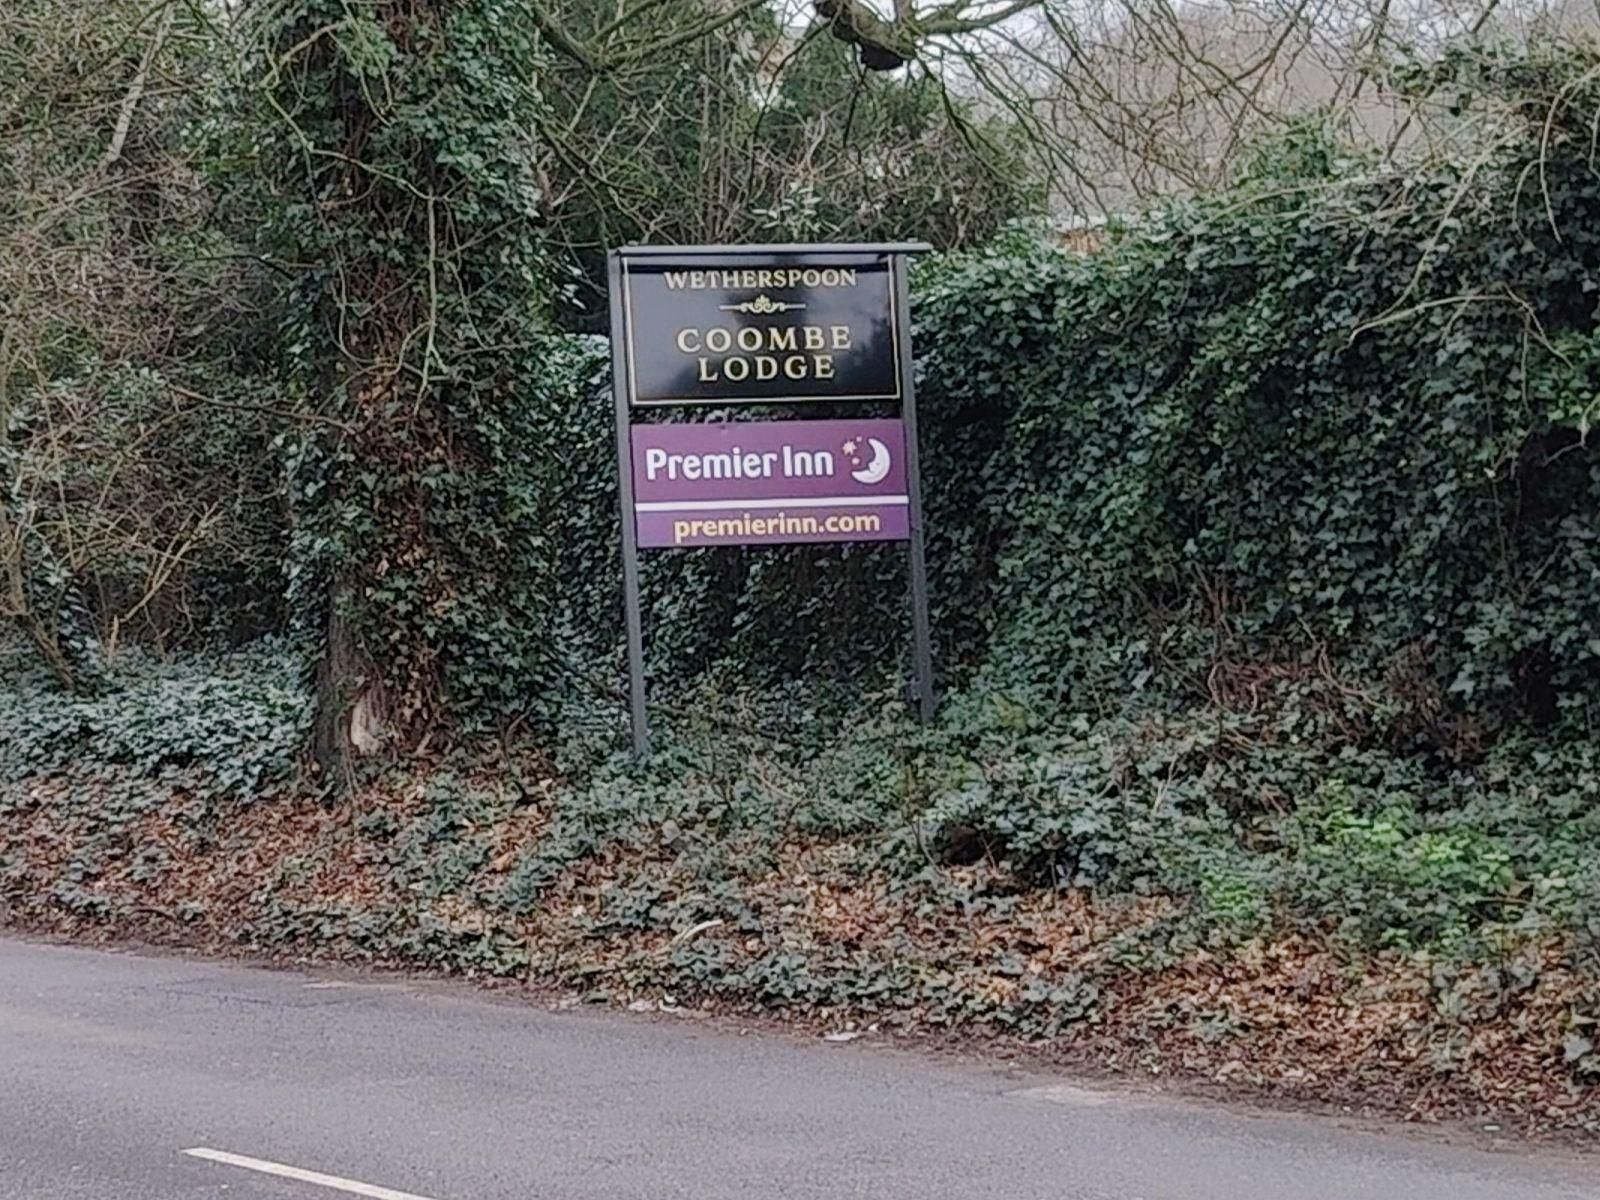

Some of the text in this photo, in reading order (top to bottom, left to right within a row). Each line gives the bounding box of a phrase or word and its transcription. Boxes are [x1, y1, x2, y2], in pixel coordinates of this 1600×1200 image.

[664, 269, 856, 289] WETHERSPOON
[677, 326, 852, 352] COOMBE
[698, 355, 835, 381] LODGE
[646, 446, 834, 480] Premier Inn
[674, 512, 880, 543] premierinn.com
